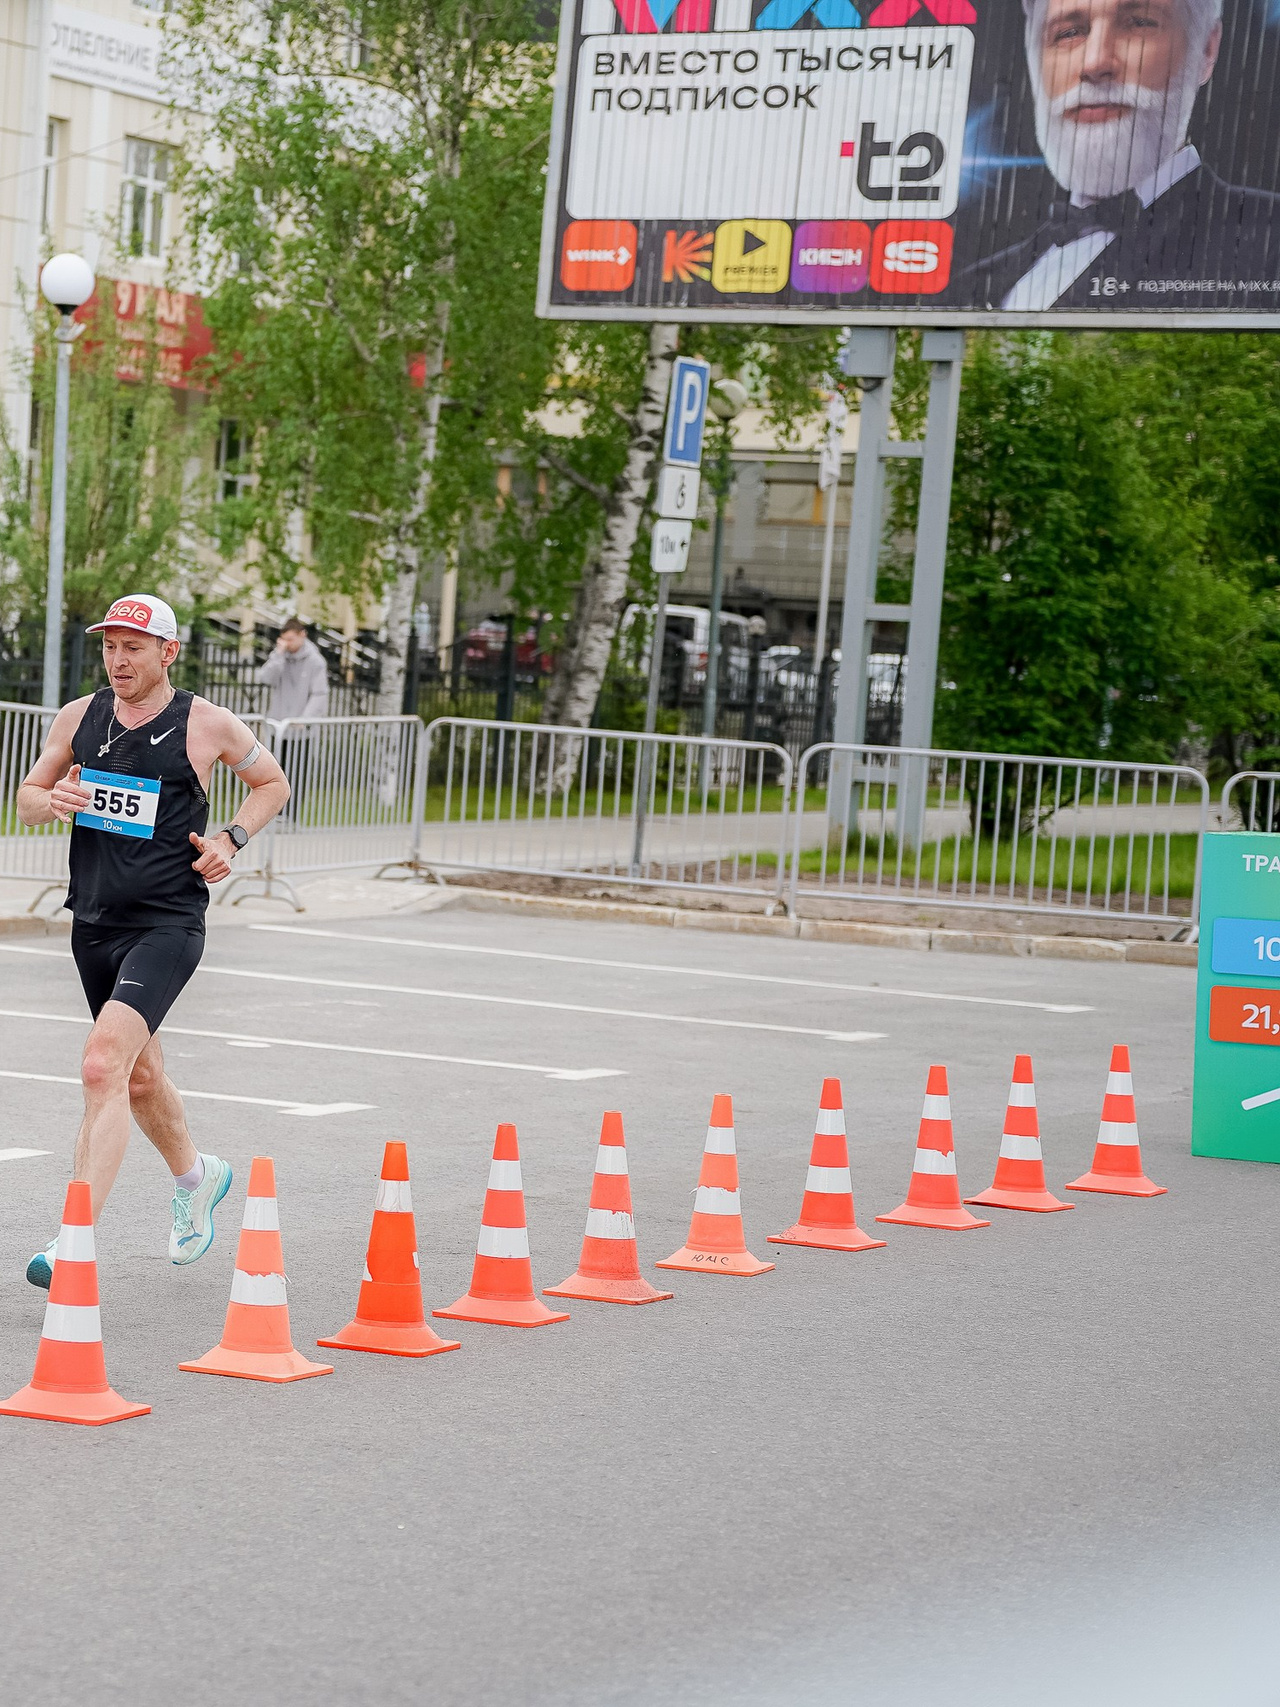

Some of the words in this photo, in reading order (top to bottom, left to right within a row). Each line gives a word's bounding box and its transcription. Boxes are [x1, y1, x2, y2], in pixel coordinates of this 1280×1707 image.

[595, 48, 759, 75] ВМЕСТО
[775, 44, 954, 73] ТЫСЯЧИ
[591, 84, 819, 115] ПОДПИСОК
[1089, 277, 1131, 296] 18+
[1137, 279, 1216, 293] ПОДРОБНЕЕ
[1218, 280, 1237, 291] НА
[677, 370, 702, 451] P
[93, 788, 141, 817] 555
[1241, 1004, 1280, 1035] 21,
